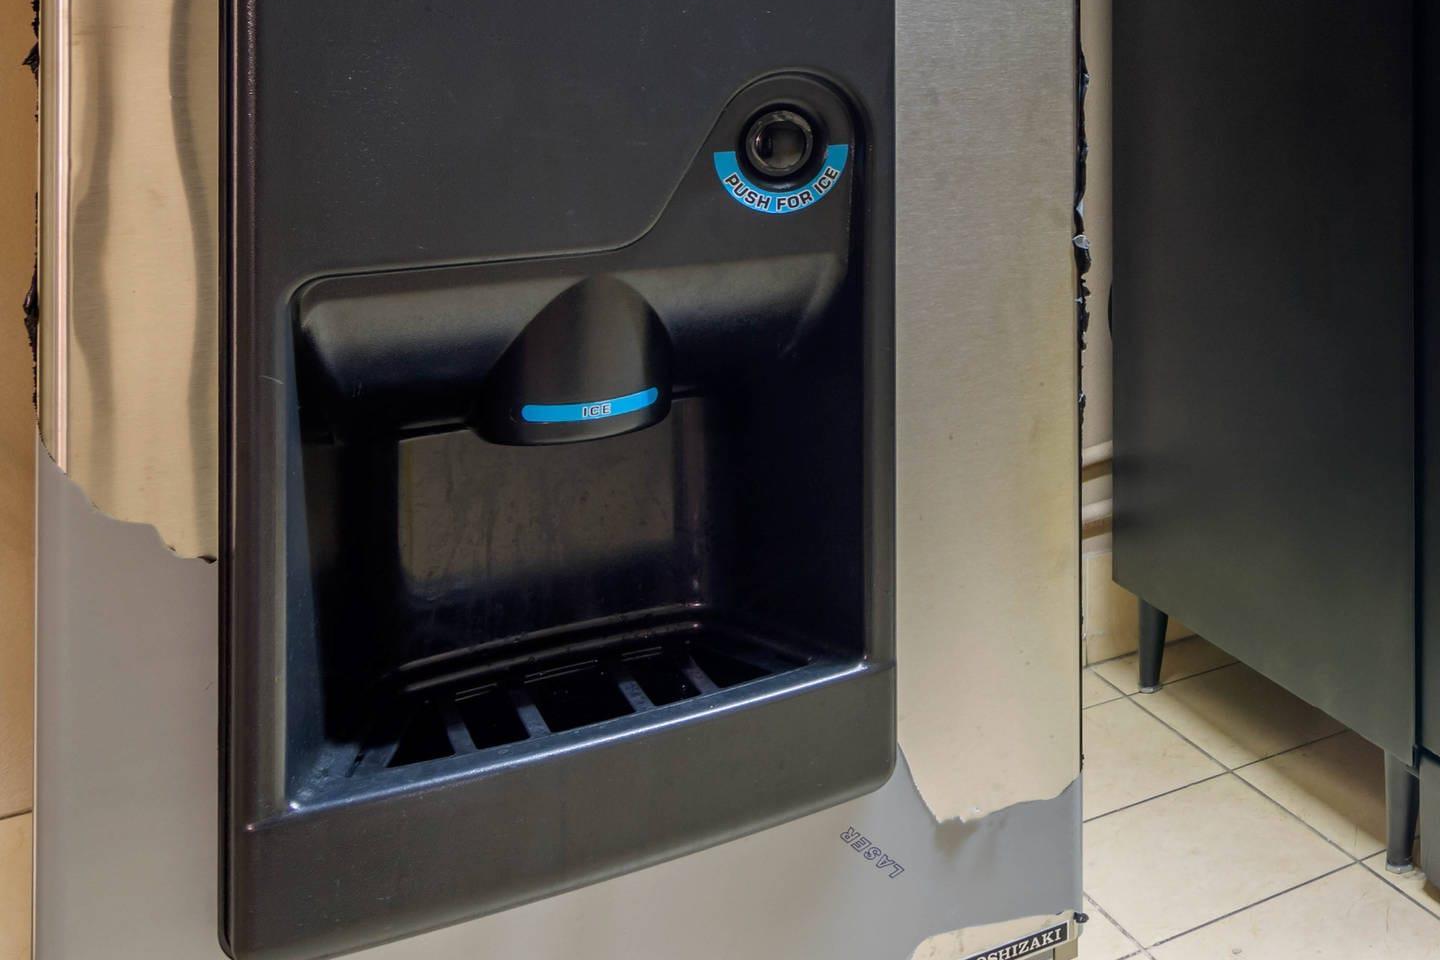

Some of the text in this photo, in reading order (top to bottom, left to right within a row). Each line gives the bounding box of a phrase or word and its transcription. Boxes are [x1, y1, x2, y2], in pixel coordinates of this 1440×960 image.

[725, 167, 839, 211] PUSH FOR ICE
[582, 403, 612, 418] ICE
[839, 826, 905, 878] LASER
